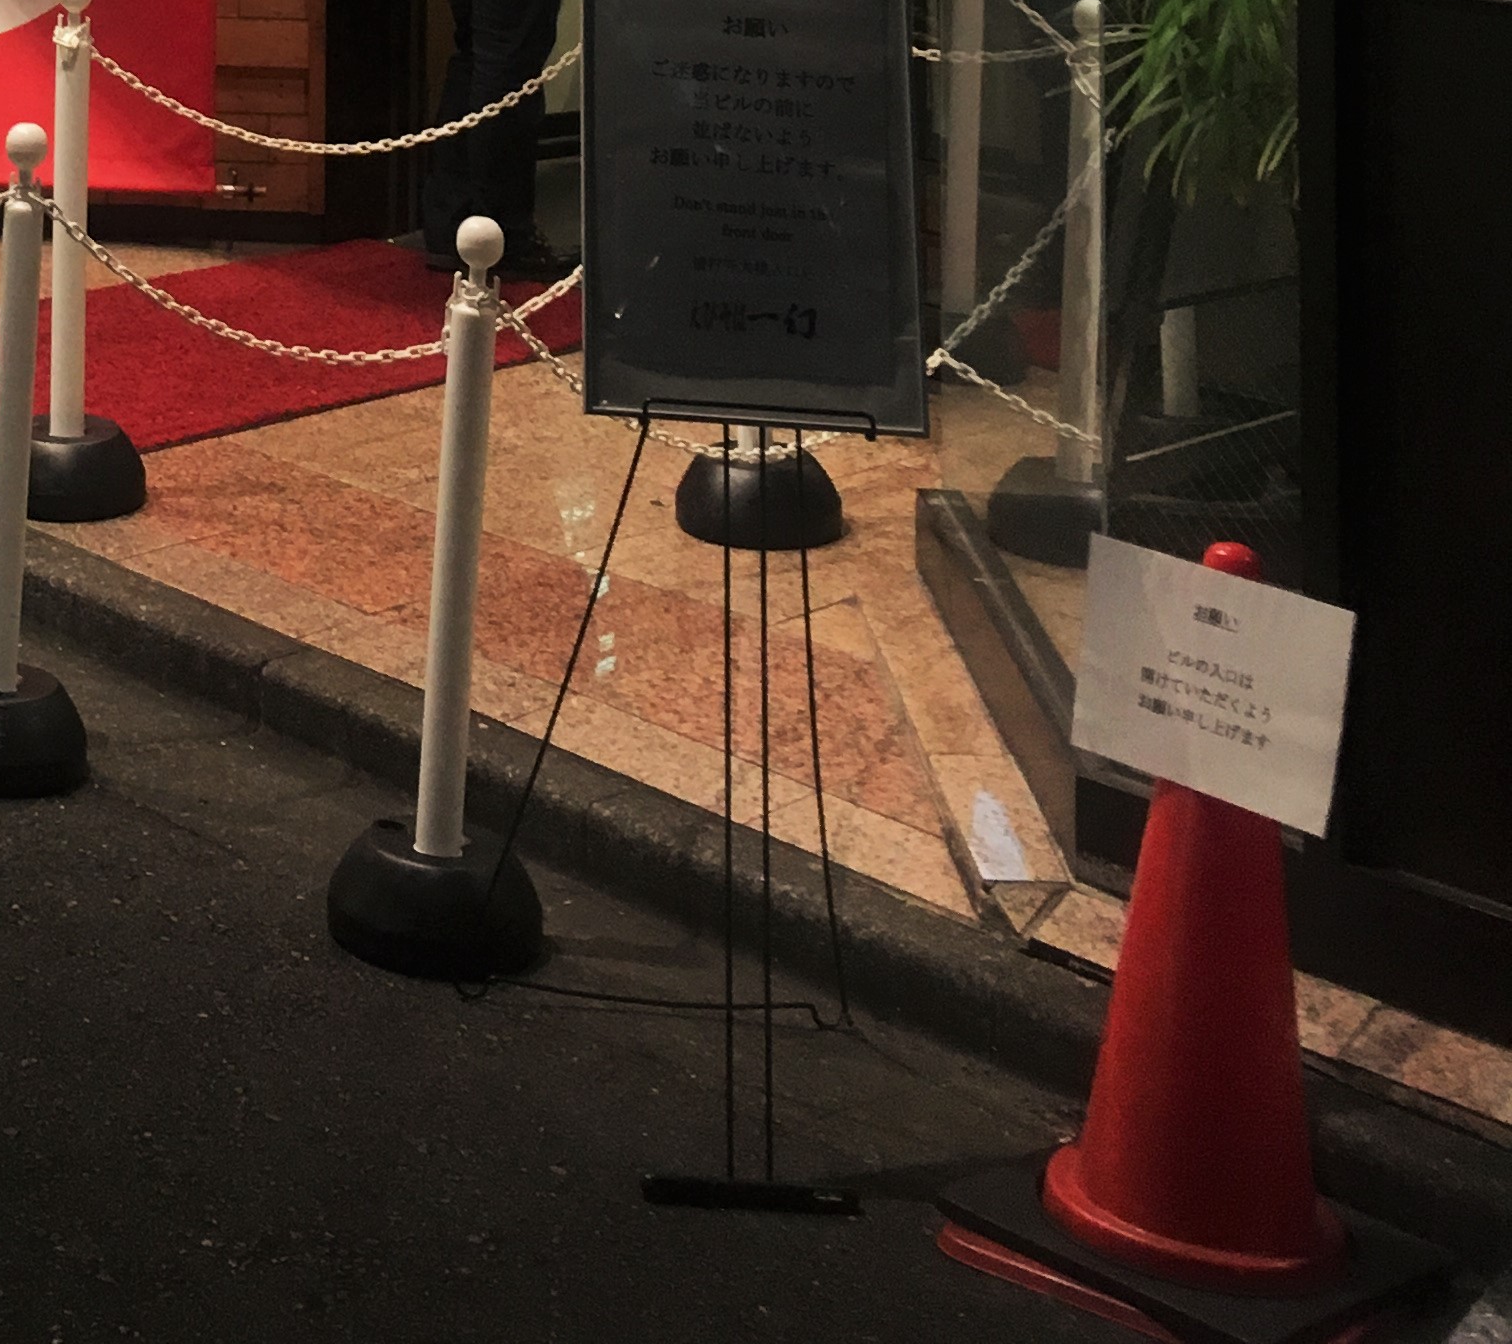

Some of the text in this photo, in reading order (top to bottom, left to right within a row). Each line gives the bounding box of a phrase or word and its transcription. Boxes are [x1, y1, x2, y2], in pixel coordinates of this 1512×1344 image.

[723, 16, 789, 38] お願い
[652, 59, 856, 93] ご迷惑になりますので
[692, 91, 815, 119] 当ビルの前に
[1168, 650, 1254, 690] ビルの入口は
